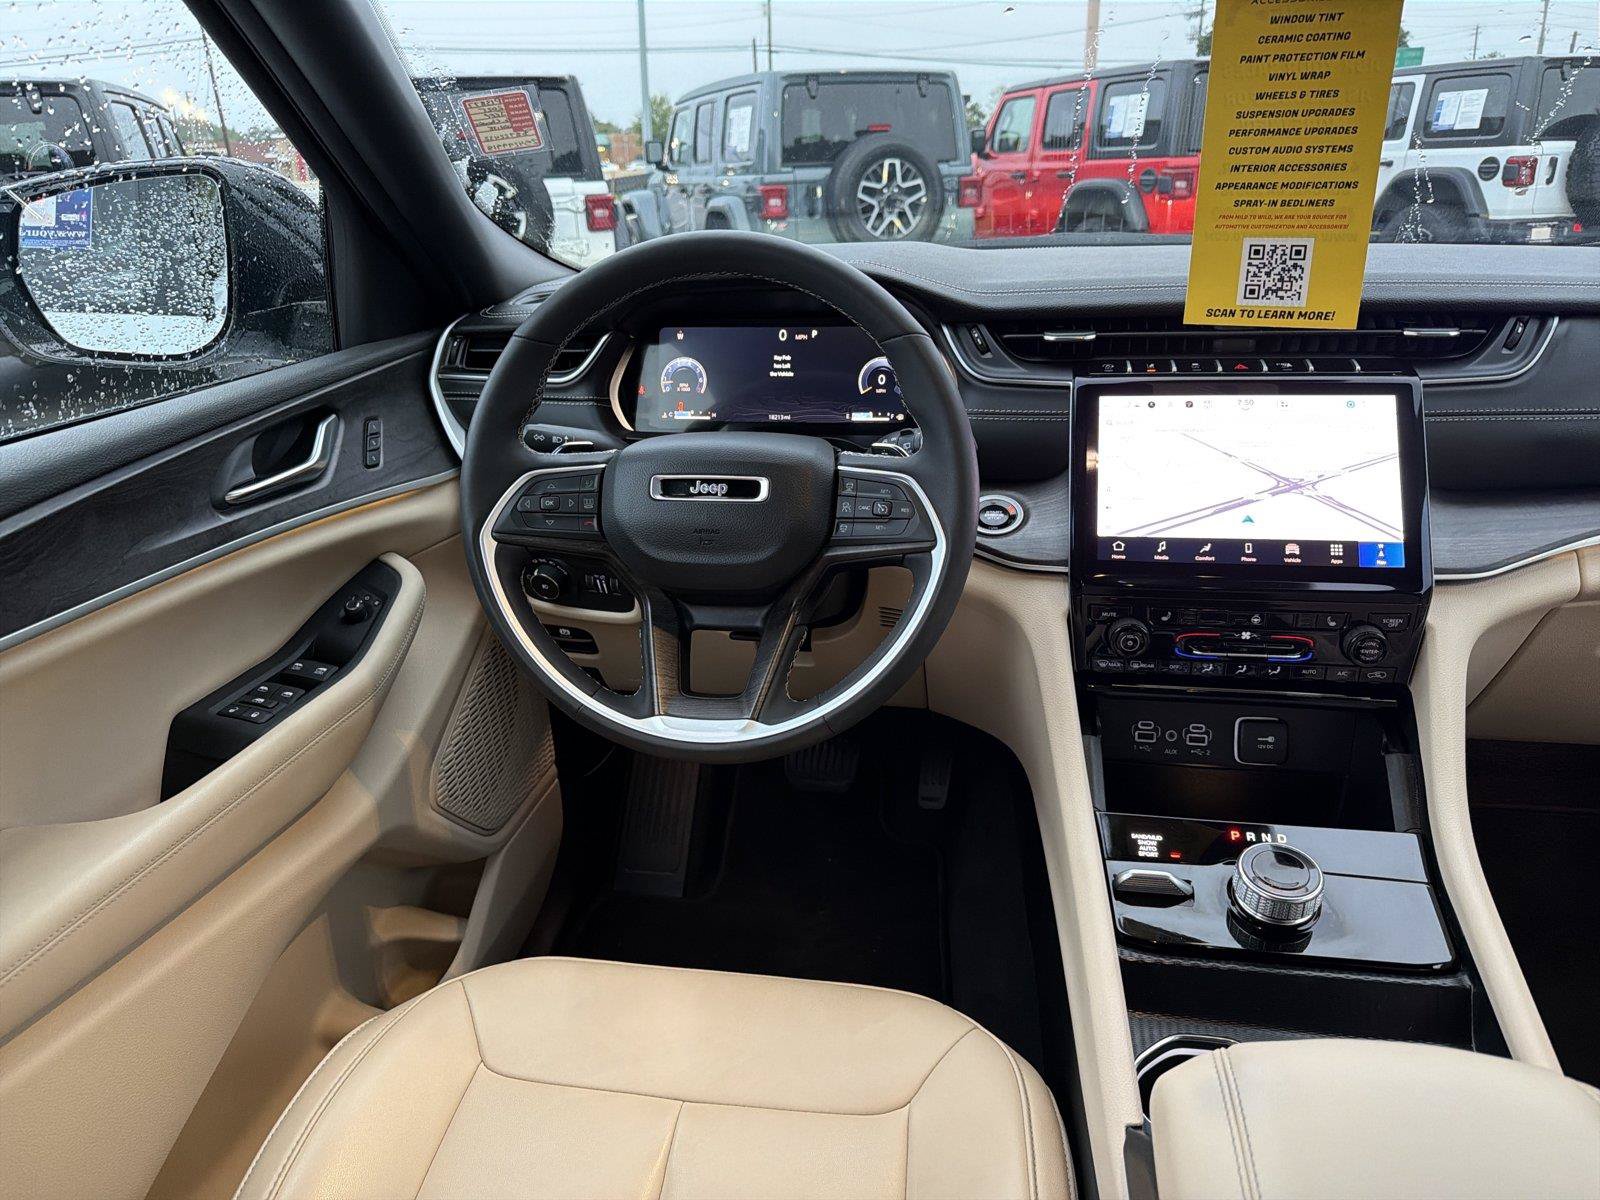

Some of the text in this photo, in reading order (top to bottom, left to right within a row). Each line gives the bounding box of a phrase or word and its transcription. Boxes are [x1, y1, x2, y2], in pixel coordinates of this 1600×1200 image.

[1270, 12, 1344, 24] WINDOW TINT
[1258, 32, 1352, 44] CERAMIC COATING
[1240, 50, 1366, 64] PAINT PROTECTION FILM
[1268, 70, 1332, 82] VINYL WRAP
[1256, 90, 1340, 100] WHEELS & TIRES
[1236, 108, 1356, 119] SUSPENSION UPGRADES
[1228, 126, 1358, 137] PERFORMANCE UPGRADES
[1228, 144, 1354, 155] CUSTOM AUDIO SYSTEMS
[1230, 163, 1348, 173] INTERIOR ACCESSORIES
[1215, 181, 1359, 190] APPEARANCE MODIFICATIONS
[1233, 199, 1335, 208] SPRAY-IN BEDLINERS
[1206, 308, 1336, 320] SCAN TO LEARN MORE!
[779, 330, 787, 341] 0
[812, 330, 818, 338] P
[878, 374, 886, 385] 0
[690, 480, 728, 497] Jeep
[1231, 831, 1286, 843] P R N D
